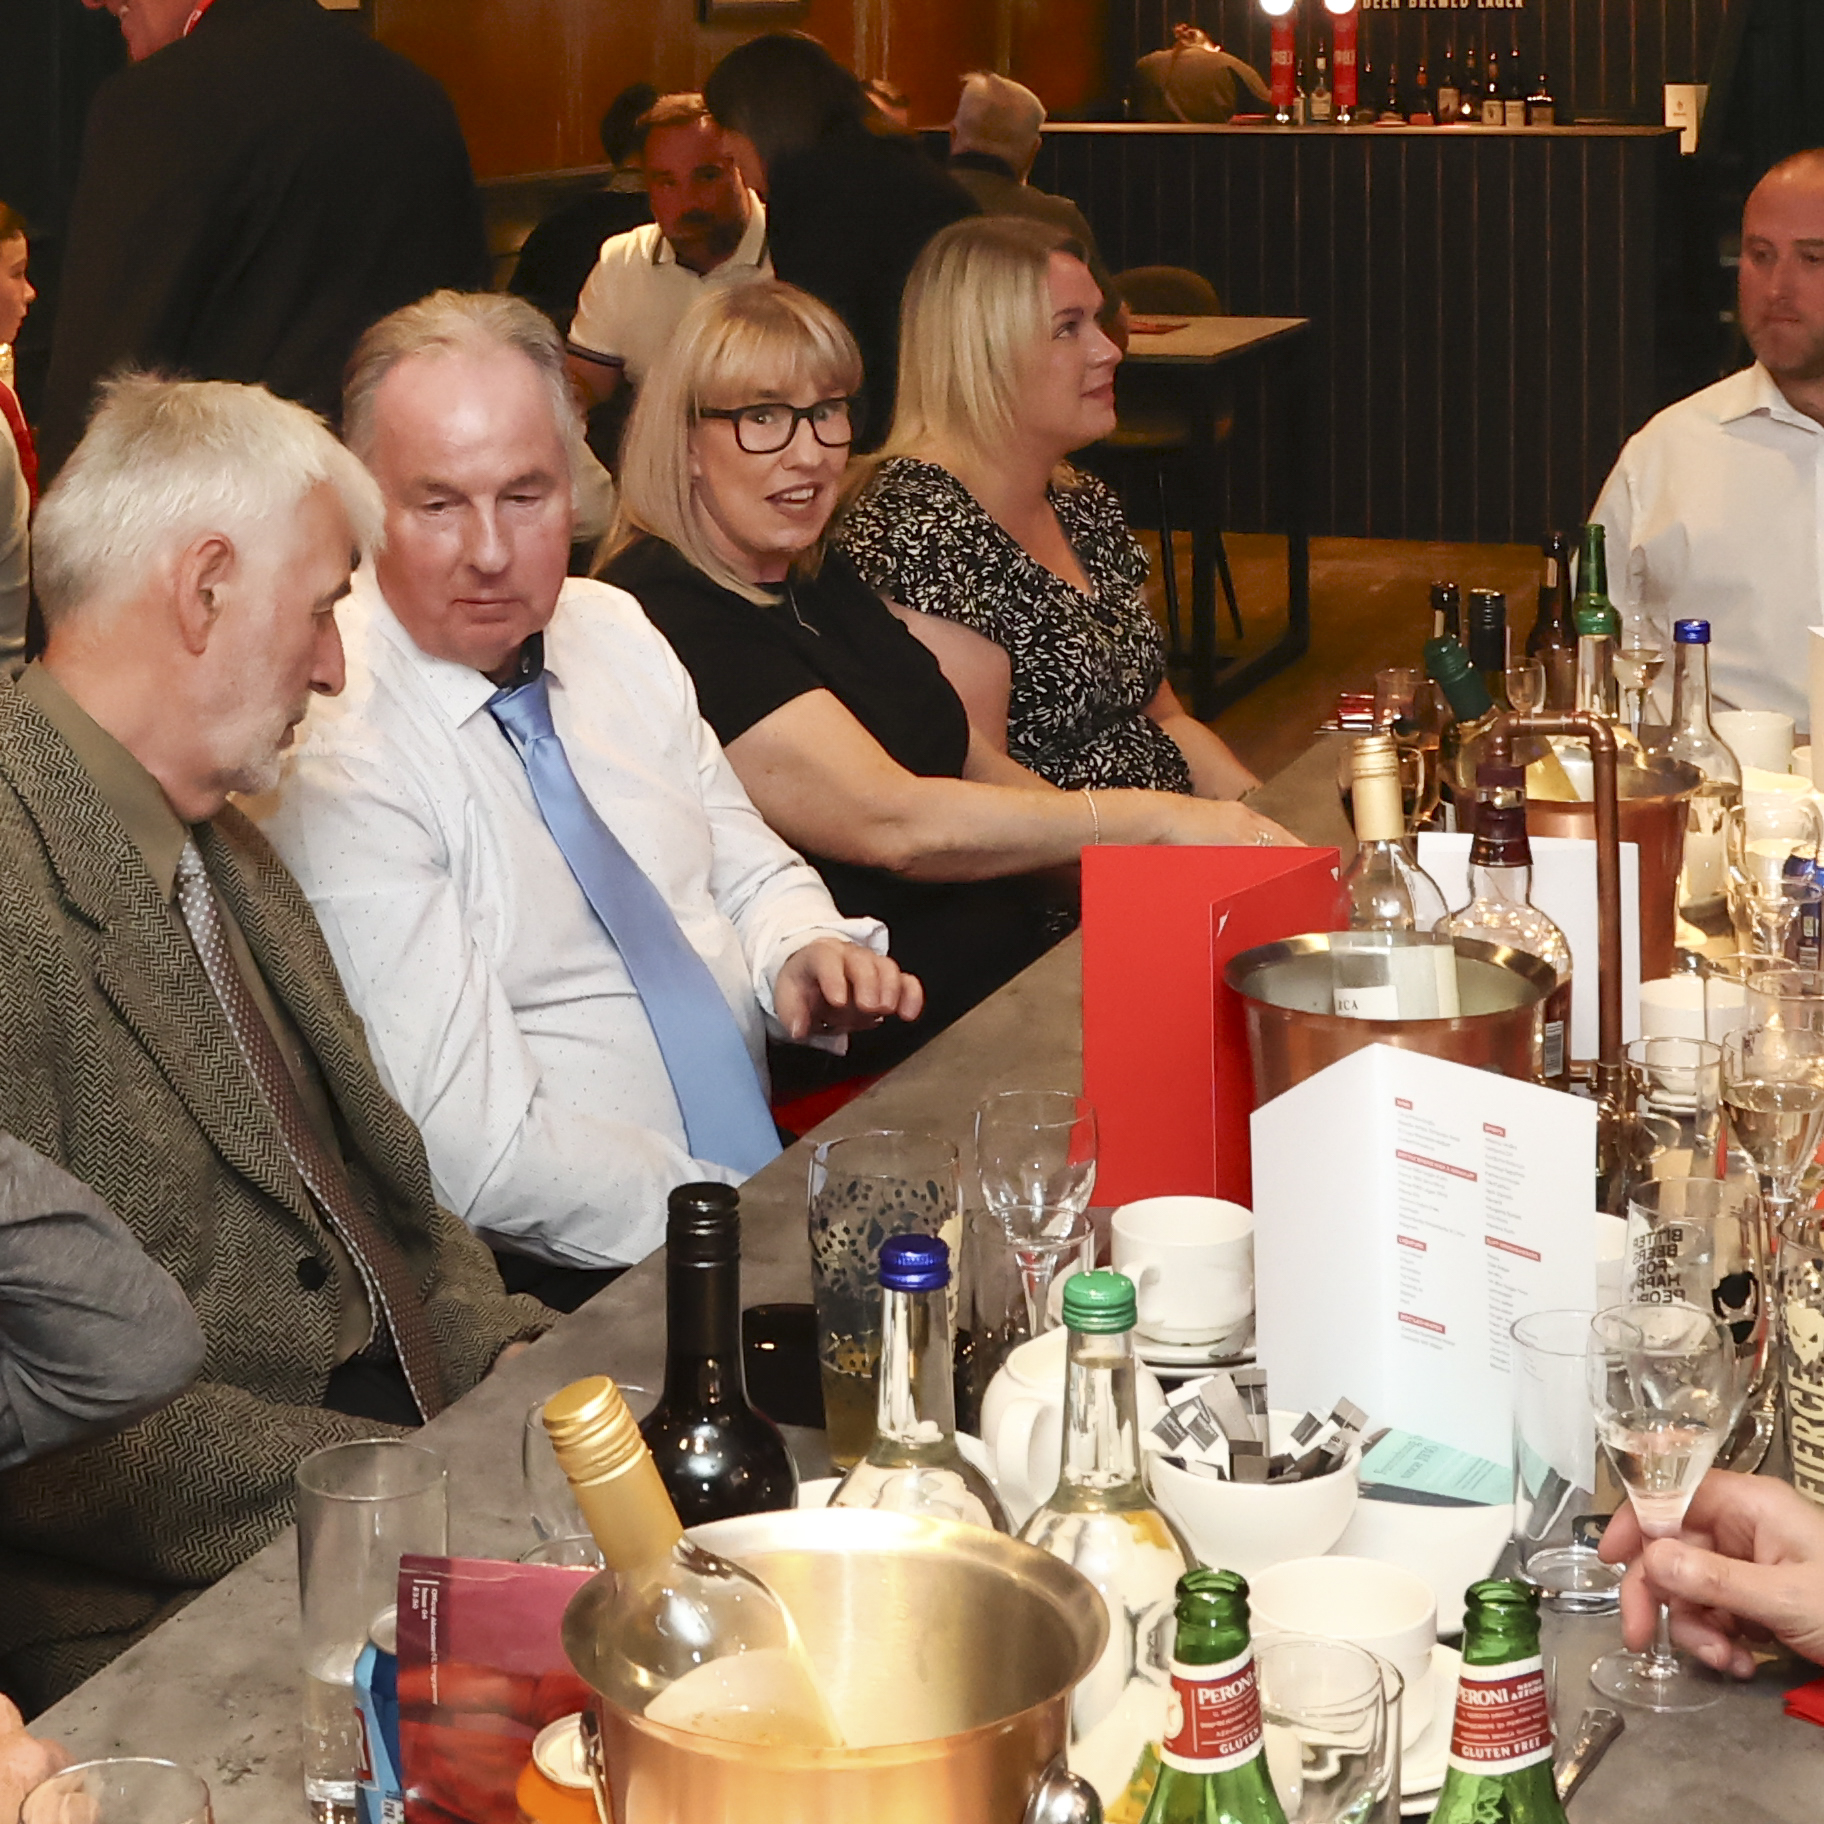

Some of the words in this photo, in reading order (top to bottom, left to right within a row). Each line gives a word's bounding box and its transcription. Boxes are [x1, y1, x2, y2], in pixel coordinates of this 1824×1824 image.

[1219, 1727, 1259, 1755] GLUTEN
[1461, 1745, 1511, 1759] GLUTEN
[1513, 1736, 1541, 1755] FREE
